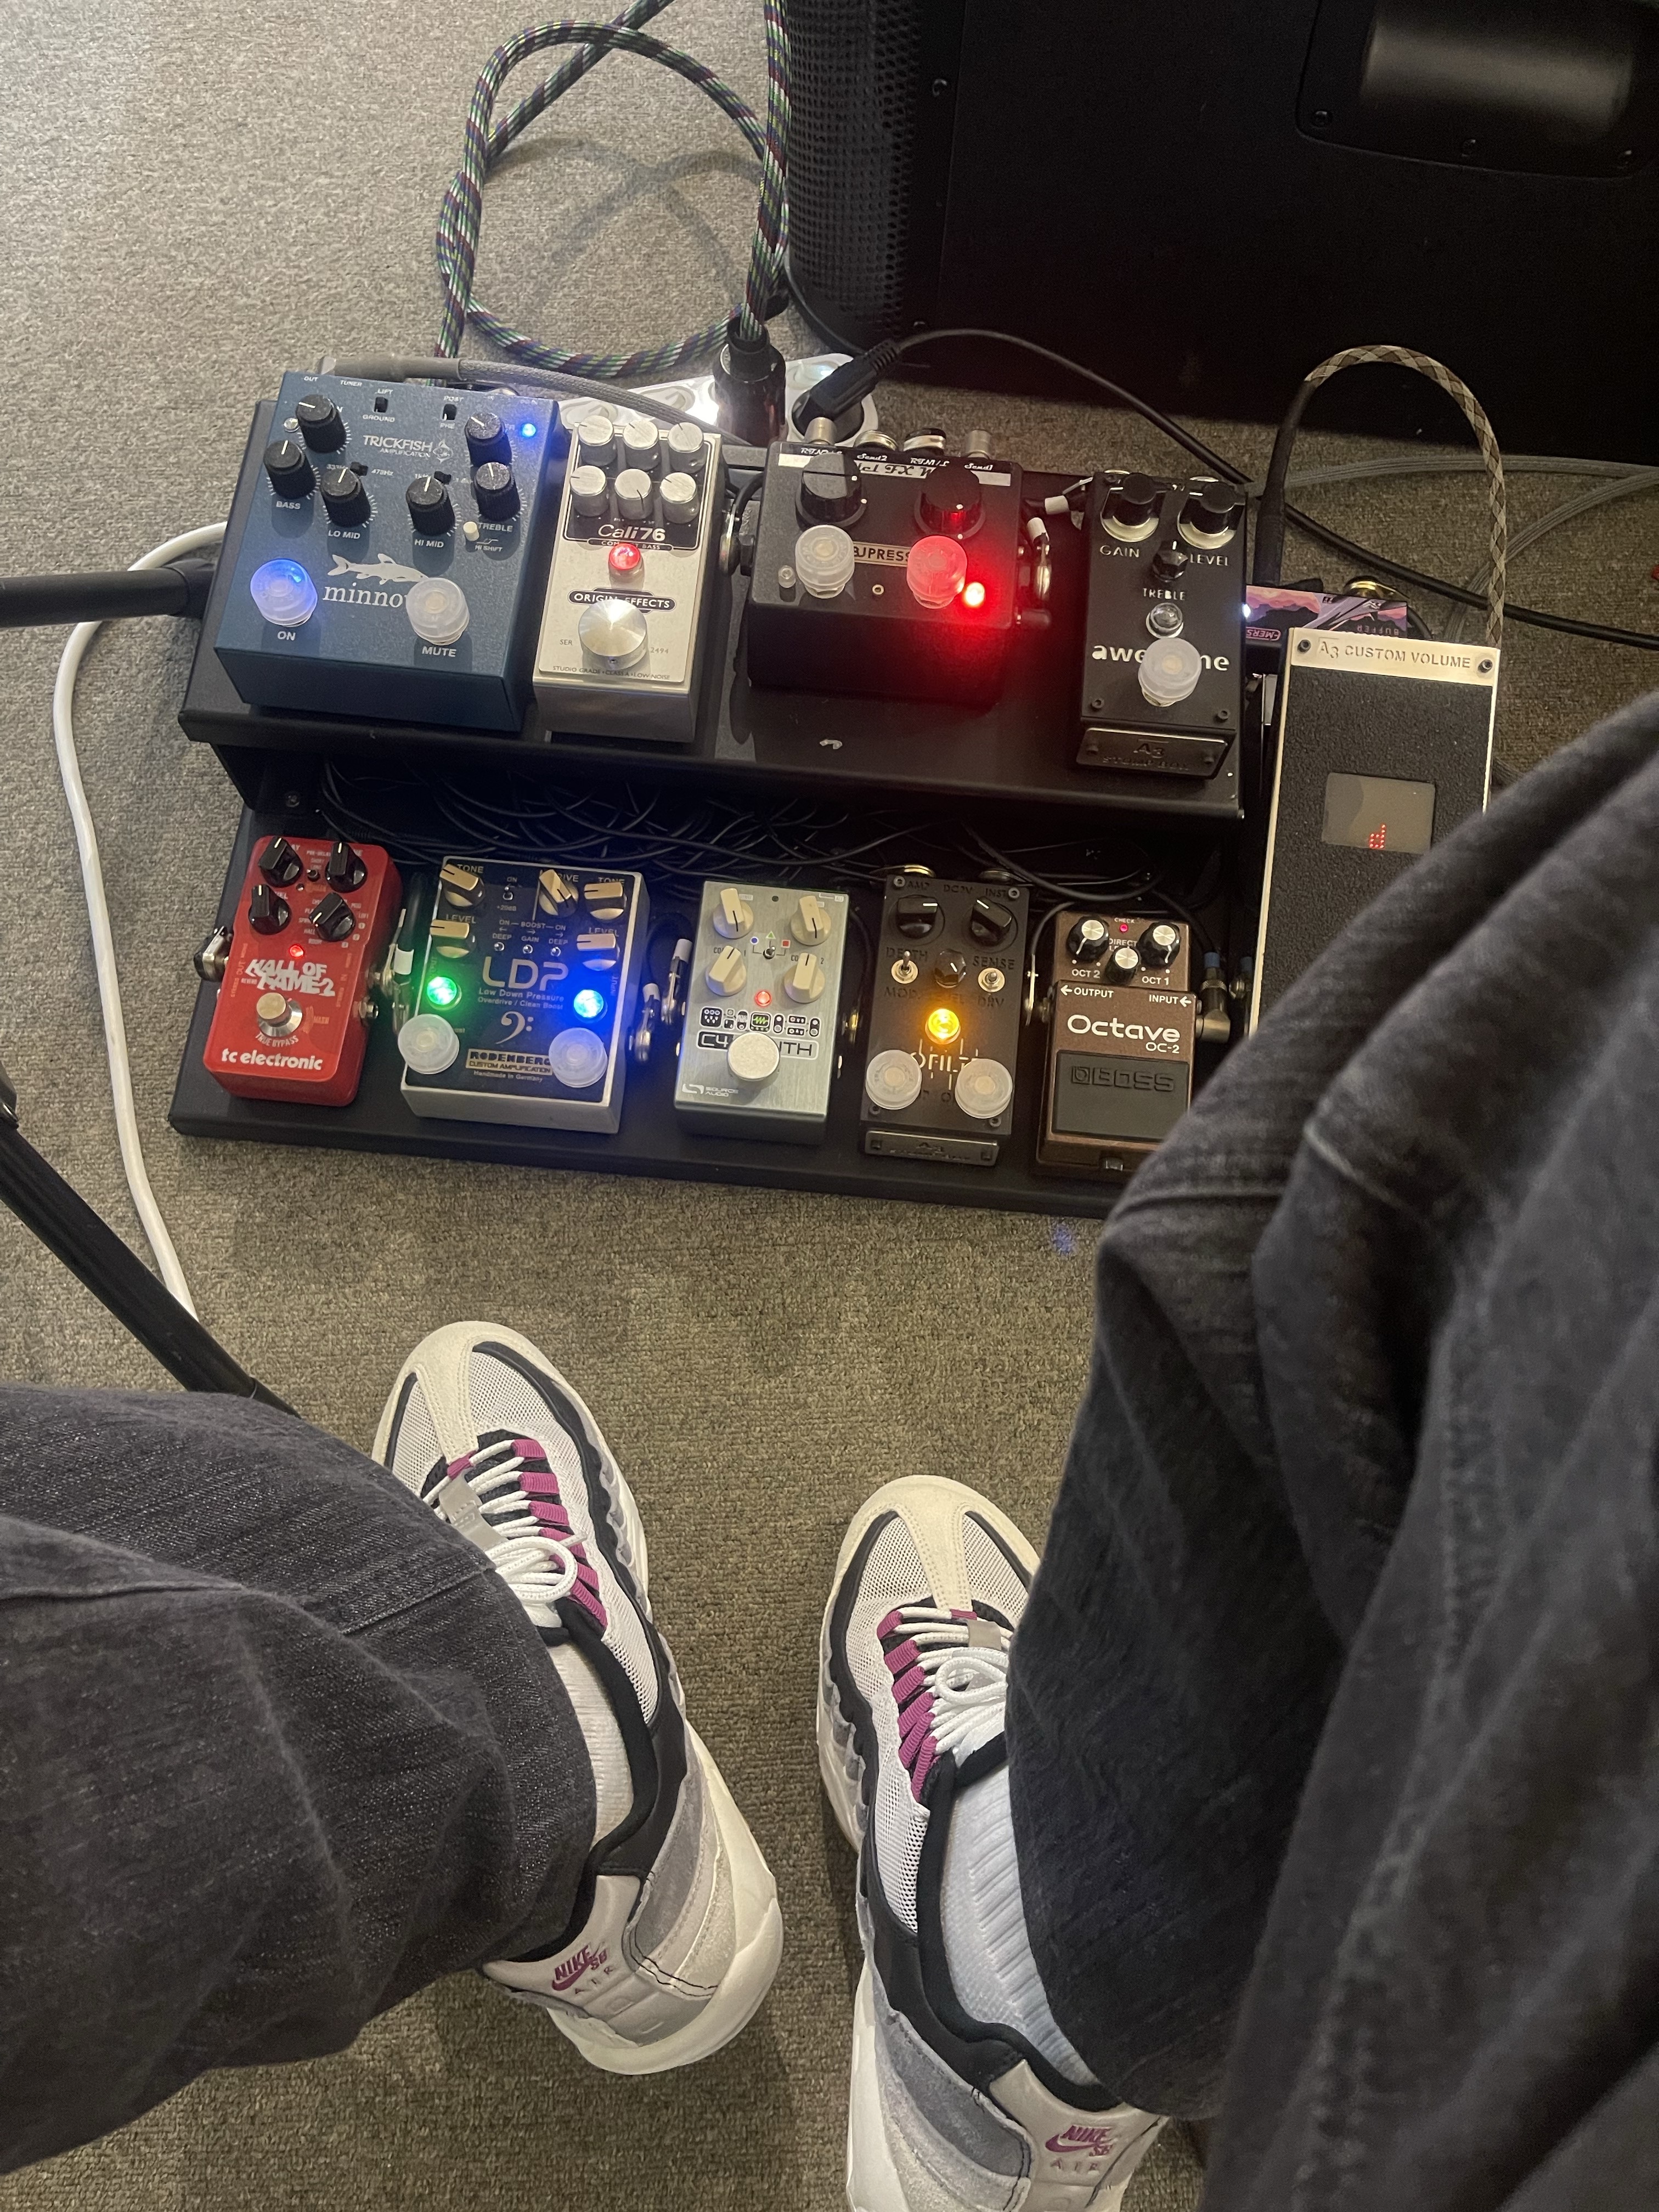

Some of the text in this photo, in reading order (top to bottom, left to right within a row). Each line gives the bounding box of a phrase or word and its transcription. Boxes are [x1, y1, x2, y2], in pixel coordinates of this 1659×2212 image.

[362, 414, 396, 422] GROUND
[363, 435, 433, 452] TRICKFISH
[380, 448, 431, 458] AMPLIFICATION
[276, 501, 301, 510] BASS
[478, 522, 514, 532] TREBLE
[328, 530, 361, 540] LO MID
[1100, 545, 1141, 558] GAIN
[1189, 554, 1229, 567] LEVEL
[323, 583, 407, 608] minno
[574, 592, 670, 608] ORIGIN EFFECTS
[1142, 588, 1186, 601] TREBLE
[277, 631, 296, 641] ON
[1357, 624, 1399, 636] BUFFER
[421, 646, 456, 657] MUTE
[1344, 645, 1406, 662] CUSTOM
[1411, 652, 1471, 669] VOLUME
[457, 864, 484, 873] TONE
[445, 914, 476, 924] LEVEL
[588, 927, 619, 937] LEVEL
[1109, 938, 1137, 946] DIRECT
[973, 955, 1015, 970] SENSE
[245, 959, 328, 980] HALL OF
[482, 956, 569, 991] LDP
[1071, 969, 1101, 979] OCT 2
[1142, 975, 1170, 985] OCT 1
[478, 988, 564, 1002] Low Down Pressure
[1074, 988, 1114, 998] OUTPUT
[1149, 994, 1179, 1005] INPUT
[478, 996, 513, 1005] Overdrive
[543, 1002, 563, 1010] Boost
[1067, 1014, 1181, 1042] Octave
[256, 1032, 299, 1047] TRUE BYPASS
[701, 1034, 729, 1048] C4
[1146, 1042, 1180, 1053] OC-2
[222, 1048, 323, 1070] tc electronic
[470, 1061, 550, 1073] CUSTOM AMPLIFICATION
[473, 1070, 506, 1079] Handmade
[516, 1074, 543, 1083] Germany
[1092, 1067, 1176, 1093] BOSS
[555, 1945, 591, 1981] NIKE
[1060, 2125, 1113, 2143] NIKE
[1049, 2157, 1100, 2173] AIR
